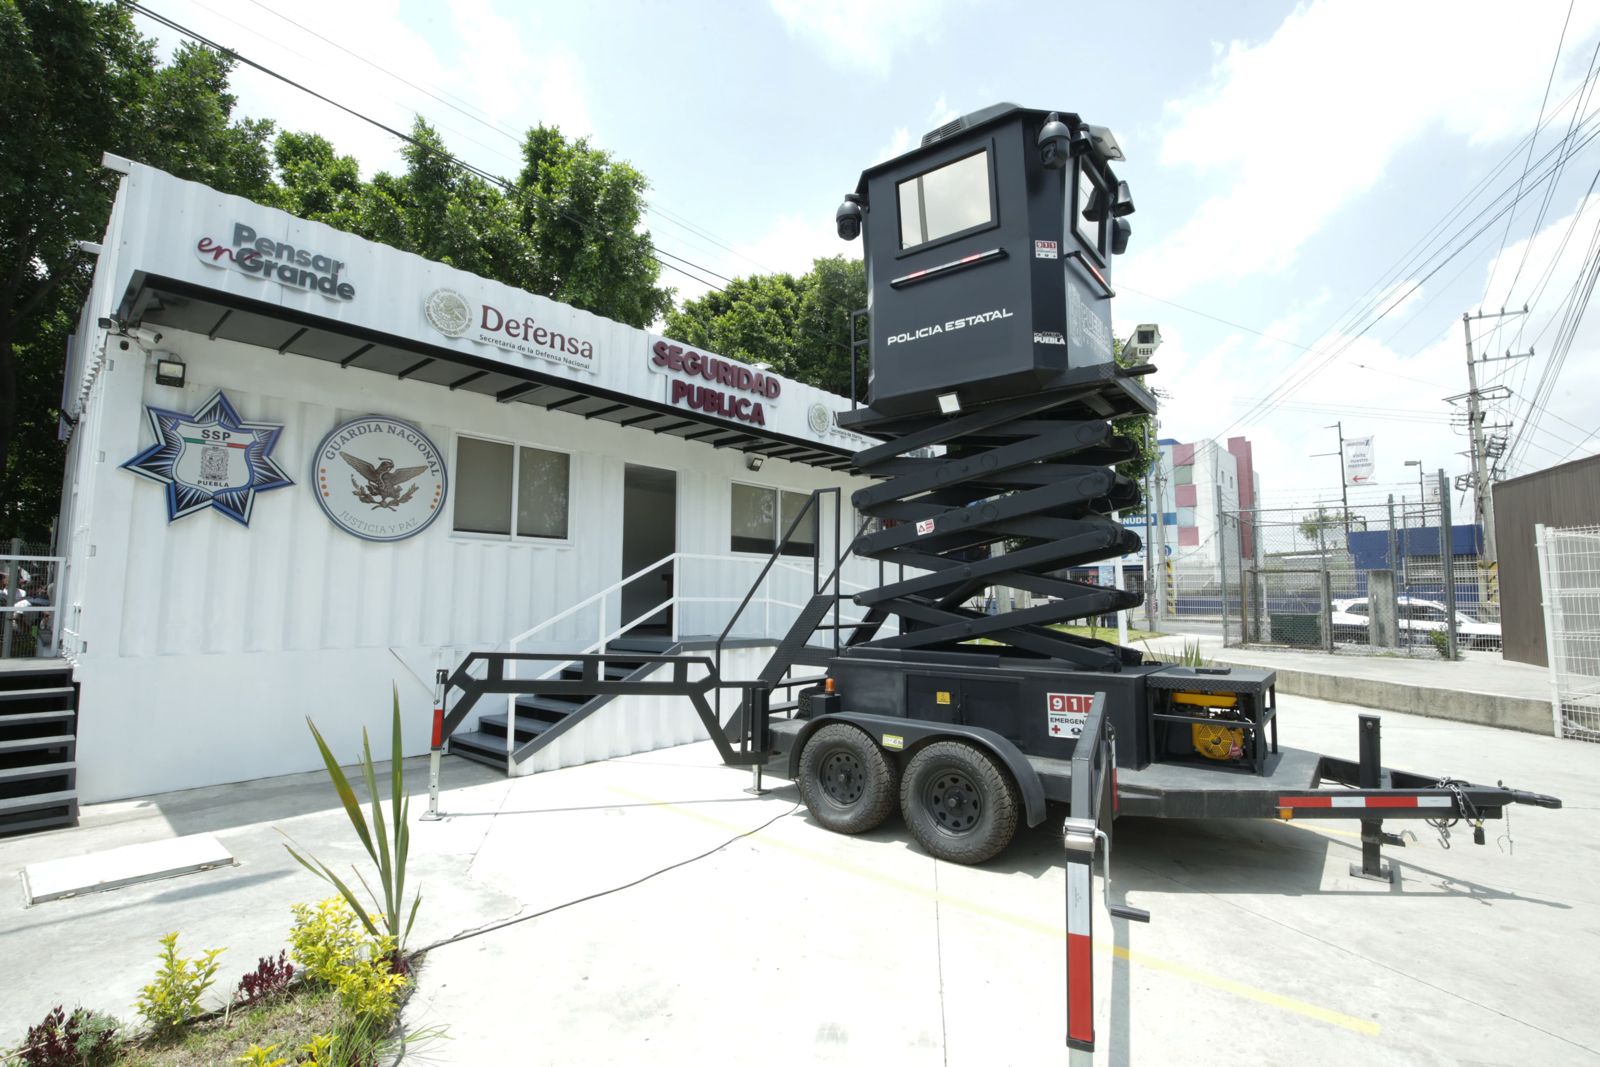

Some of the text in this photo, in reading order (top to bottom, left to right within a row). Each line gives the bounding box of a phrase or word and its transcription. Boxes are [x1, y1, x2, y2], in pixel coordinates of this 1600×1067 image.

[197, 237, 355, 300] en Grande
[232, 222, 345, 274] Pensar
[480, 304, 593, 360] Defensa
[887, 308, 1013, 346] POLICIA ESTATAL
[1034, 336, 1066, 345] PUEBLA
[517, 344, 526, 353] de
[535, 349, 562, 362] Defensa
[562, 356, 590, 369] Nacional
[652, 340, 781, 399] SEGURIDAD
[671, 379, 765, 426] PUBLICA
[201, 429, 231, 441] SSP
[325, 423, 440, 477] GUARDIA NACIONAL
[197, 480, 229, 488] PUEBLA
[339, 510, 418, 533] JUSTICIA Y PAZ
